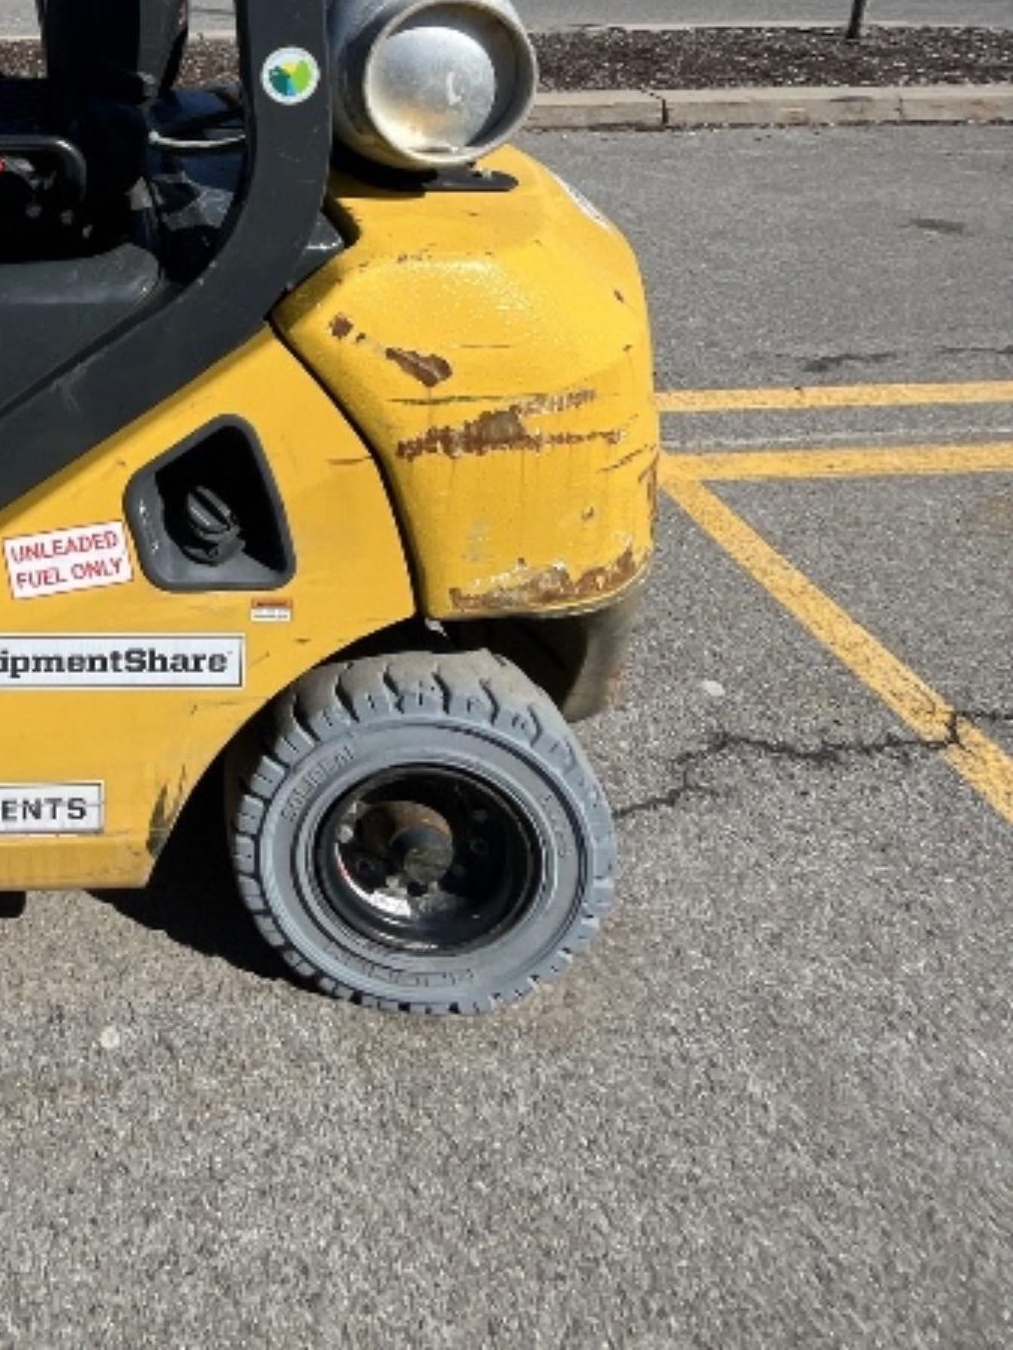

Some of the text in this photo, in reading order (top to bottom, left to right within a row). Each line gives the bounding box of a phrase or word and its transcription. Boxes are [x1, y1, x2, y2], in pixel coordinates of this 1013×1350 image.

[10, 529, 119, 564] UNLEADED
[16, 557, 123, 589] FUEL ONLY
